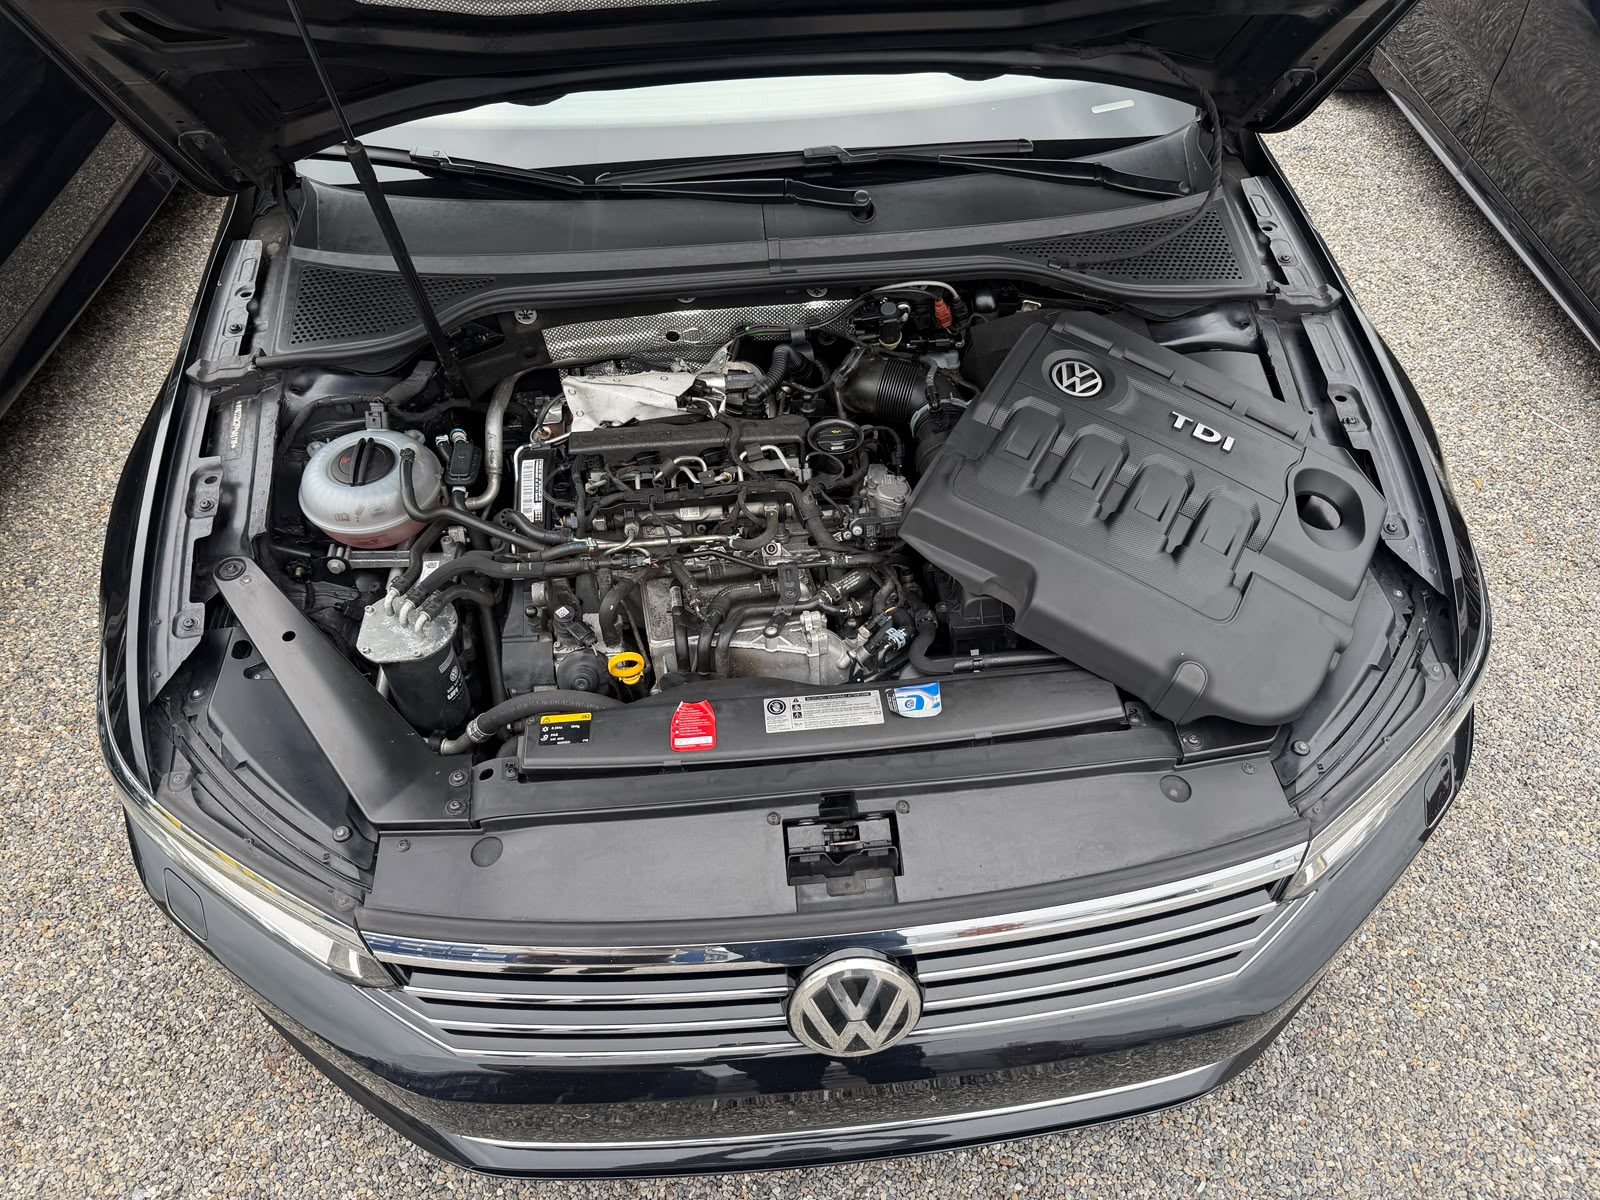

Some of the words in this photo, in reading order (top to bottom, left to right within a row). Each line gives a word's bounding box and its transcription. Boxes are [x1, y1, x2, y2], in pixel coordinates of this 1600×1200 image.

[1052, 361, 1102, 397] VW
[1171, 411, 1235, 452] TDI
[794, 963, 917, 1055] VW
